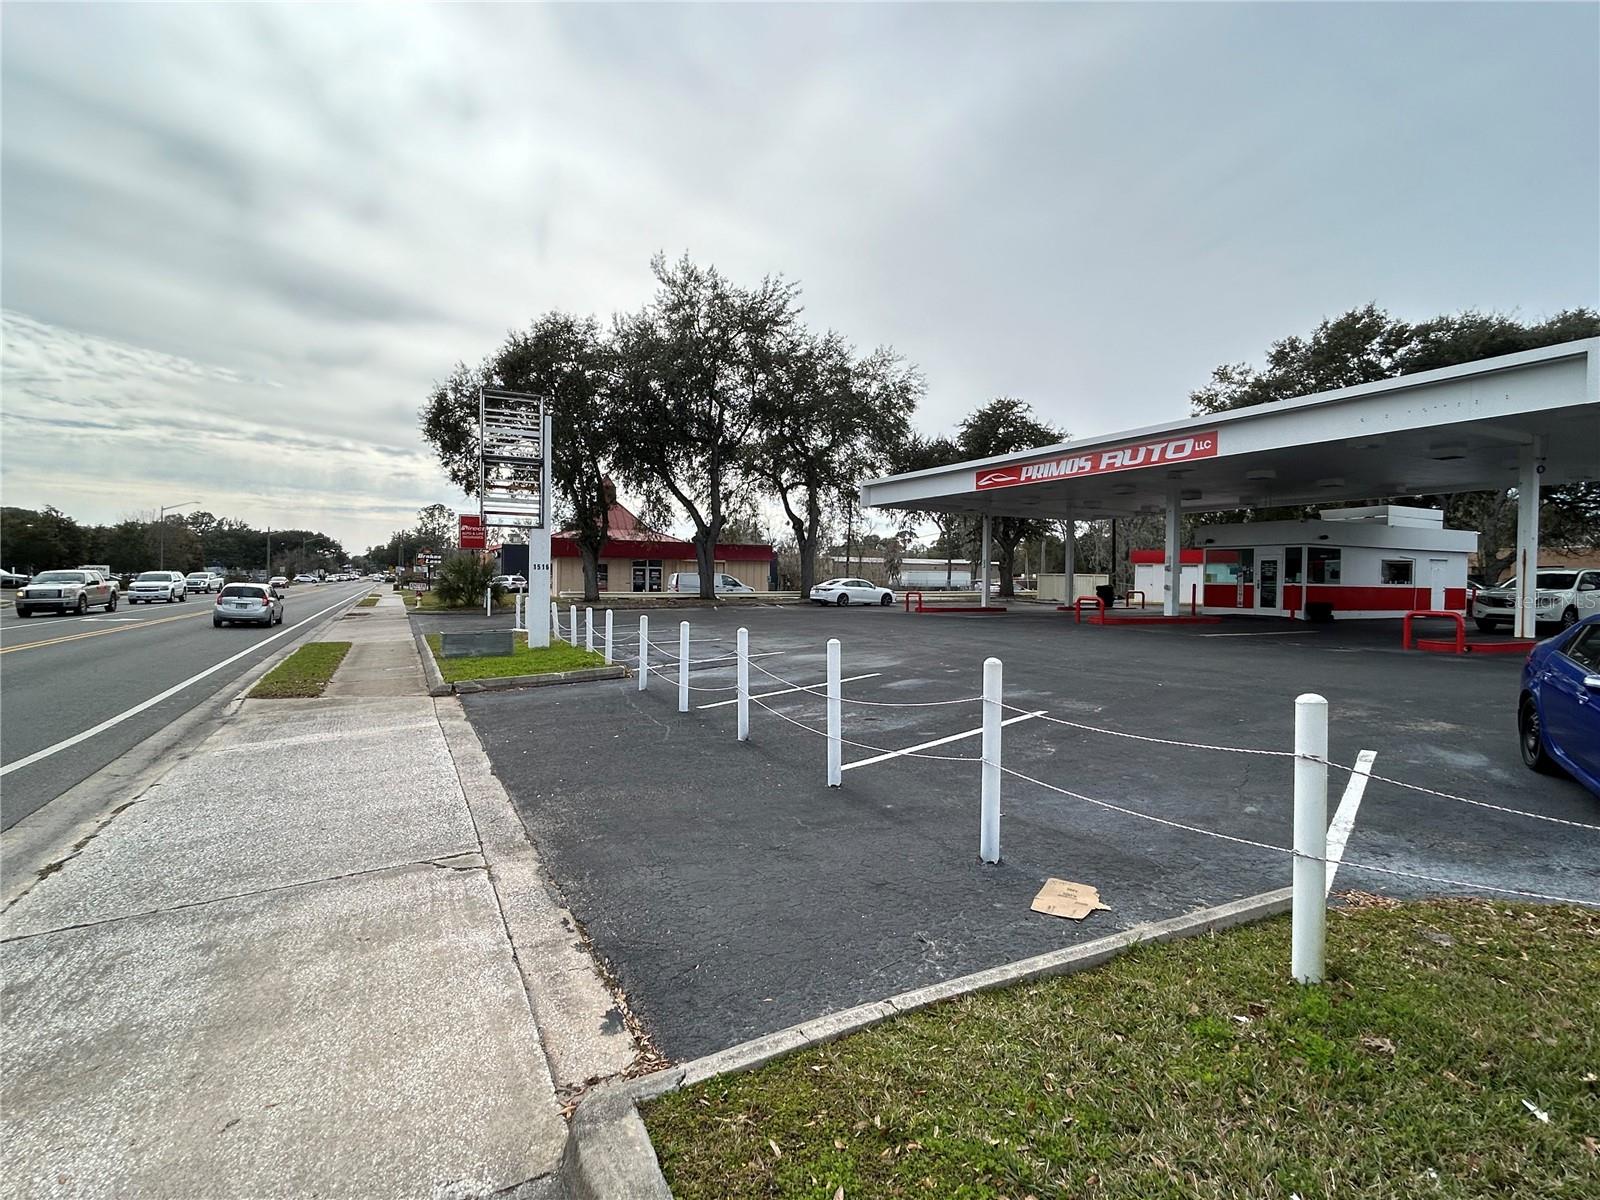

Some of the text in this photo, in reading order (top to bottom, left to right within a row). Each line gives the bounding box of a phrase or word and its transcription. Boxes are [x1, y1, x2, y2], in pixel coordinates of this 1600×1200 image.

[1020, 438, 1212, 481] PRIMOS AUTO LLC
